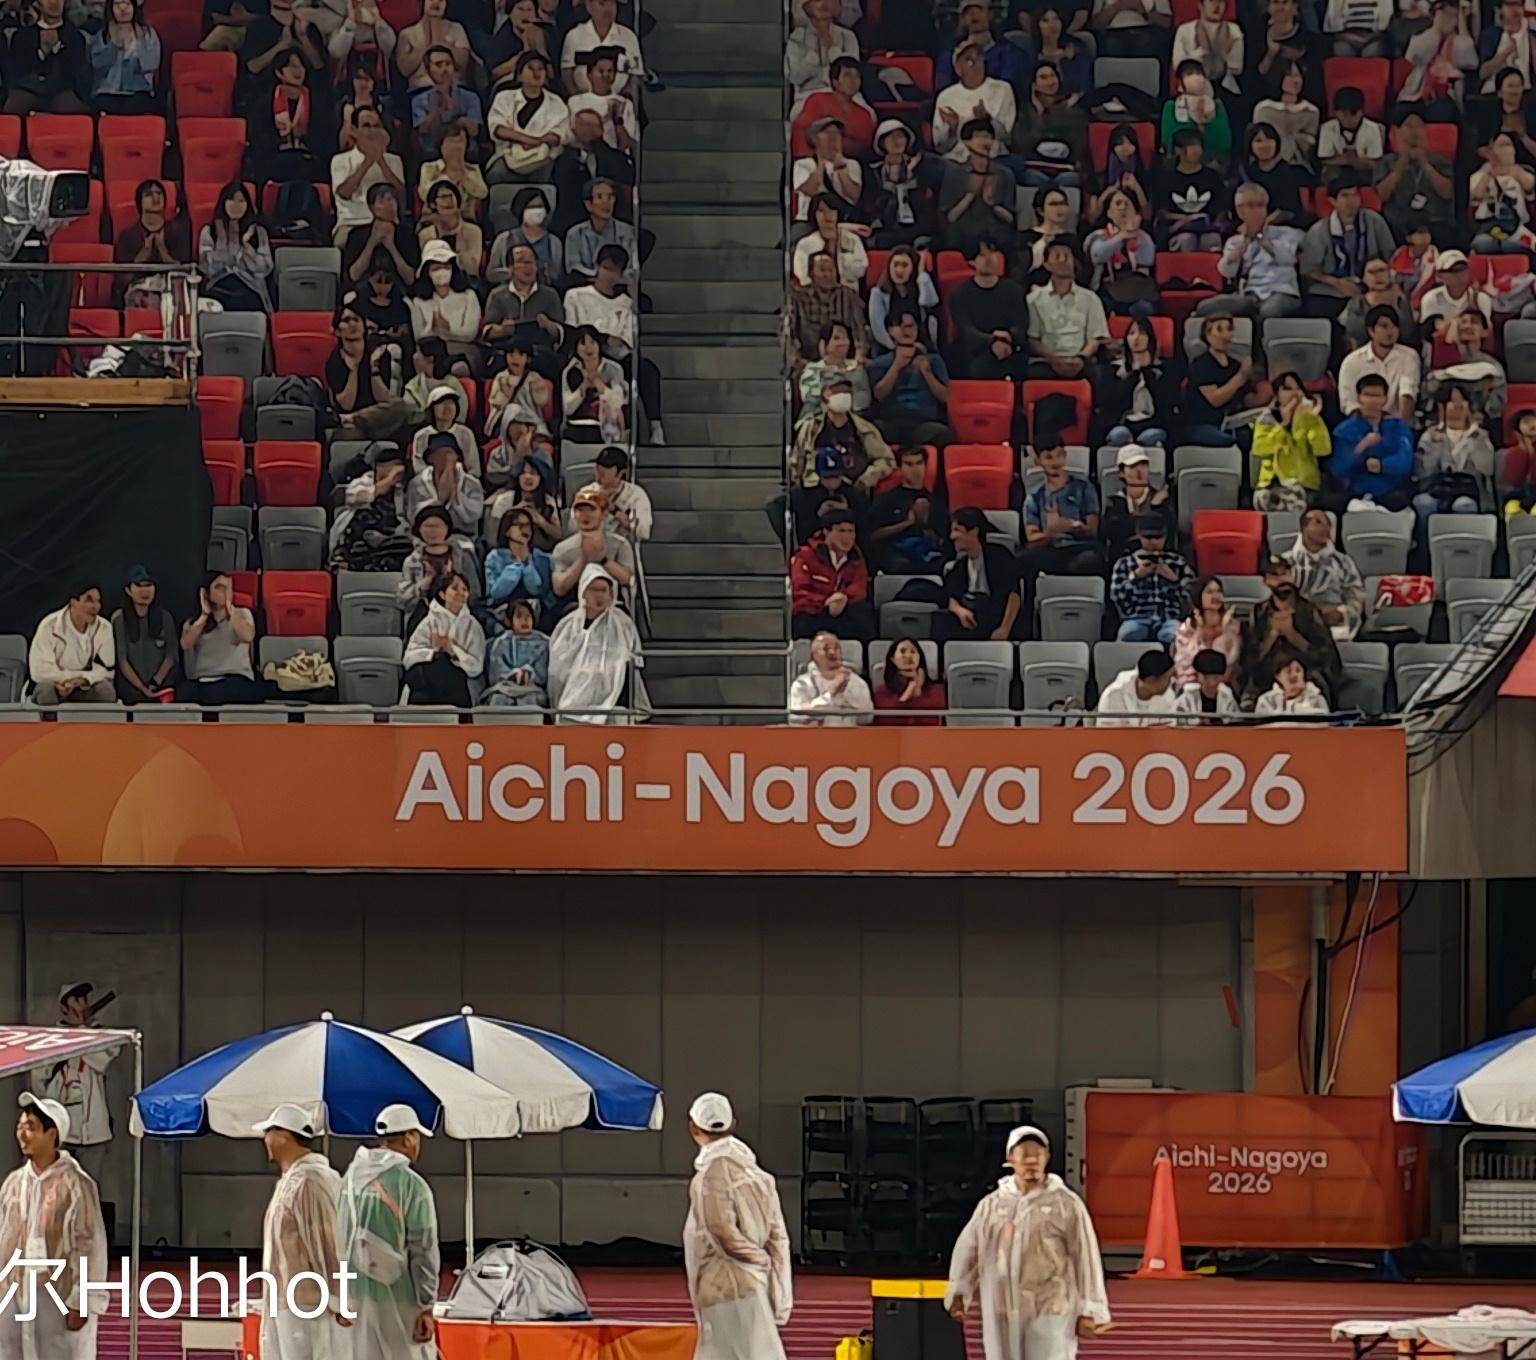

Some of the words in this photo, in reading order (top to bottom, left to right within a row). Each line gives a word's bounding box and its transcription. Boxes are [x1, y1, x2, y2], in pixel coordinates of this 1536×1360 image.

[395, 742, 1041, 847] Aichi-Nagoya
[1072, 752, 1306, 826] 2026
[1208, 1172, 1272, 1194] 2026
